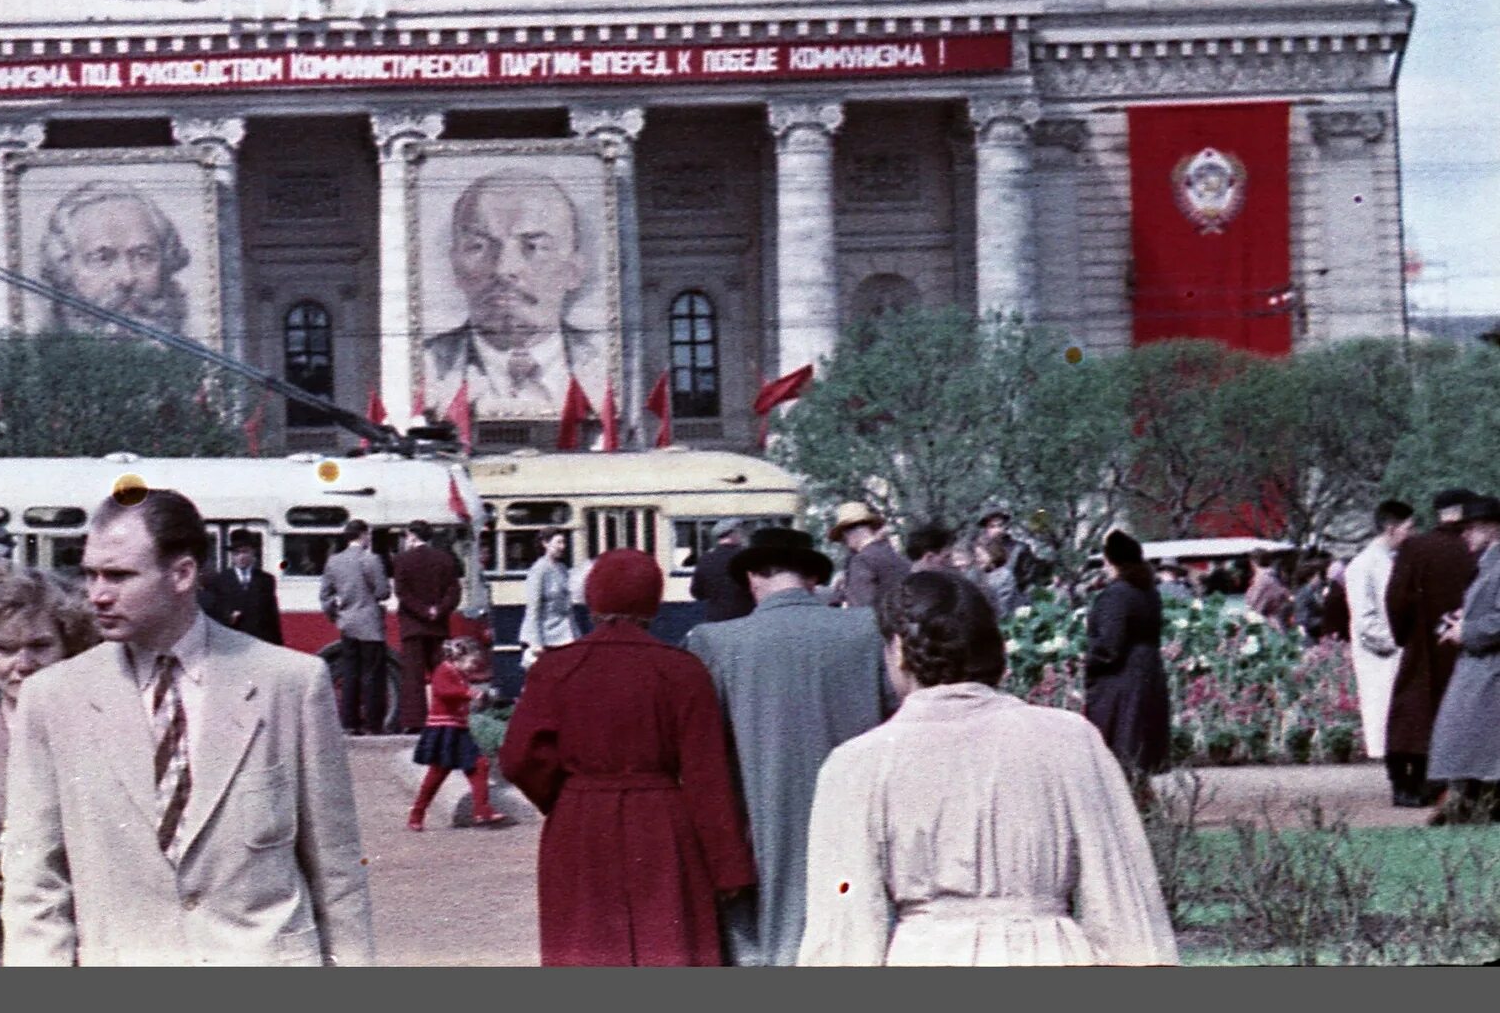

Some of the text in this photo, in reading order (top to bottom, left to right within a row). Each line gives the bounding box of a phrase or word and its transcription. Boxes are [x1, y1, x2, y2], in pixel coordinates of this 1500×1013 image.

[81, 62, 122, 87] ПОД
[130, 57, 283, 85] РУКОВОДСТВОМ
[290, 50, 489, 80] КОММУНИСТИЧЕСКОЙ
[677, 50, 692, 74] К
[703, 47, 779, 73] ПОБЕДЕ
[789, 43, 925, 70] КОММУНИЗМА
